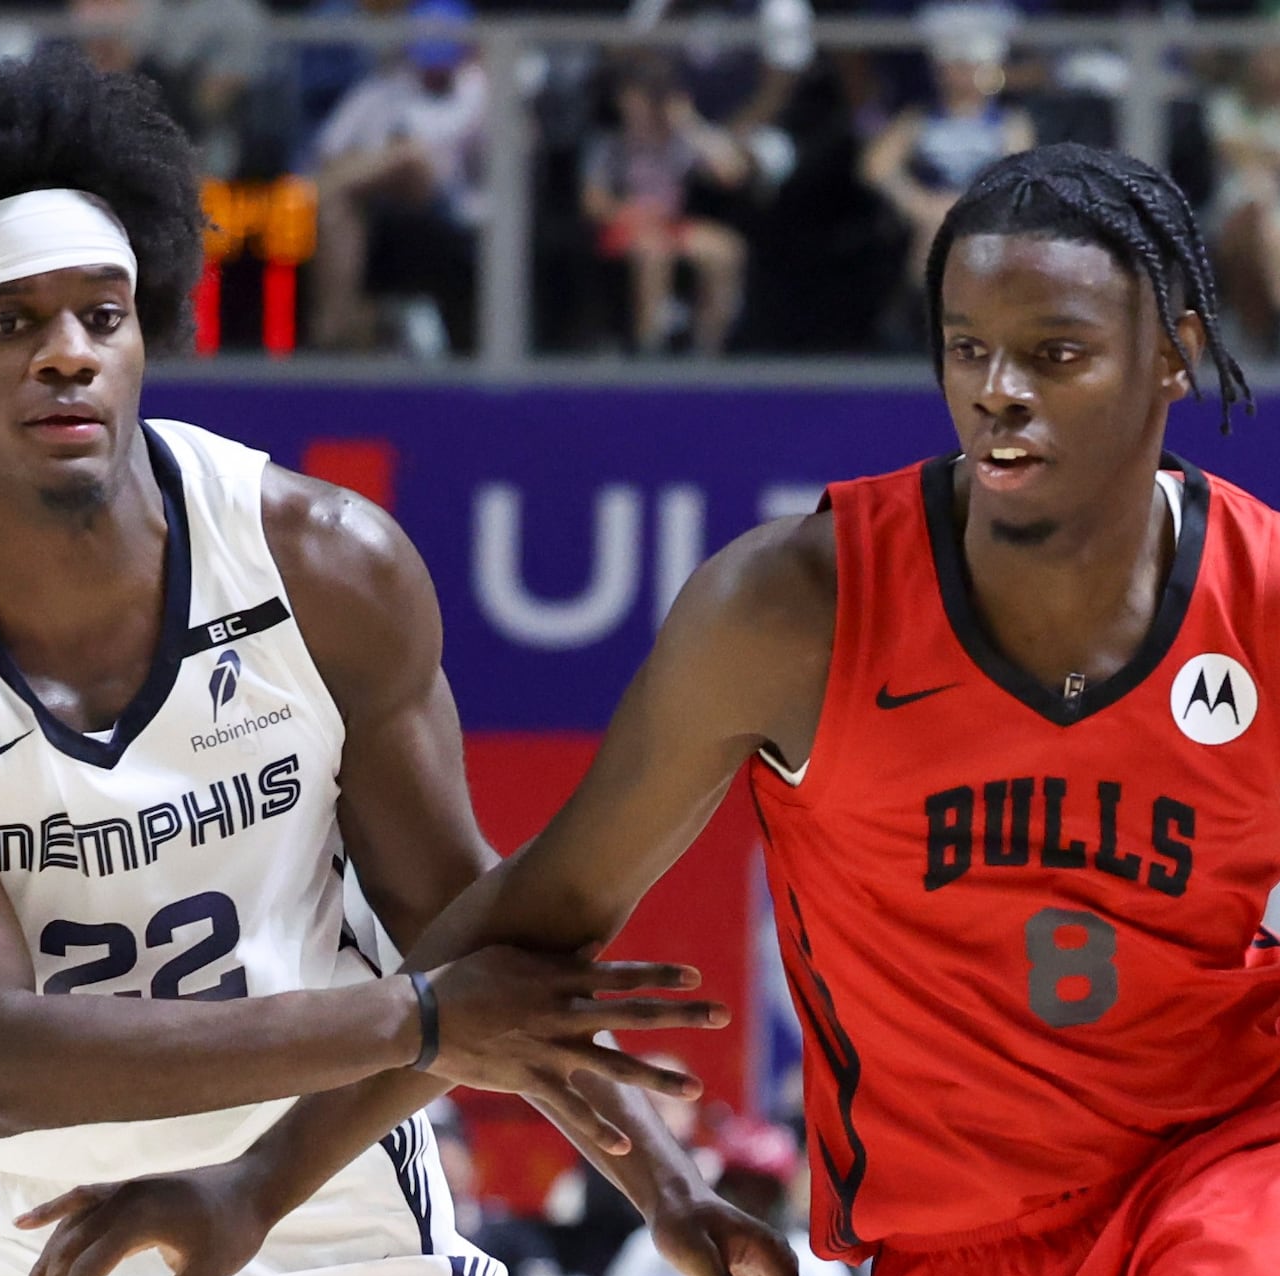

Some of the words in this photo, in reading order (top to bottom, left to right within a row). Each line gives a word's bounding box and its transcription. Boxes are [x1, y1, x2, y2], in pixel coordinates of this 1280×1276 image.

[207, 616, 248, 643] BC
[190, 704, 293, 753] Robinhood
[924, 777, 1196, 898] BULLS
[39, 891, 249, 1001] 22
[1024, 906, 1119, 1029] 8
